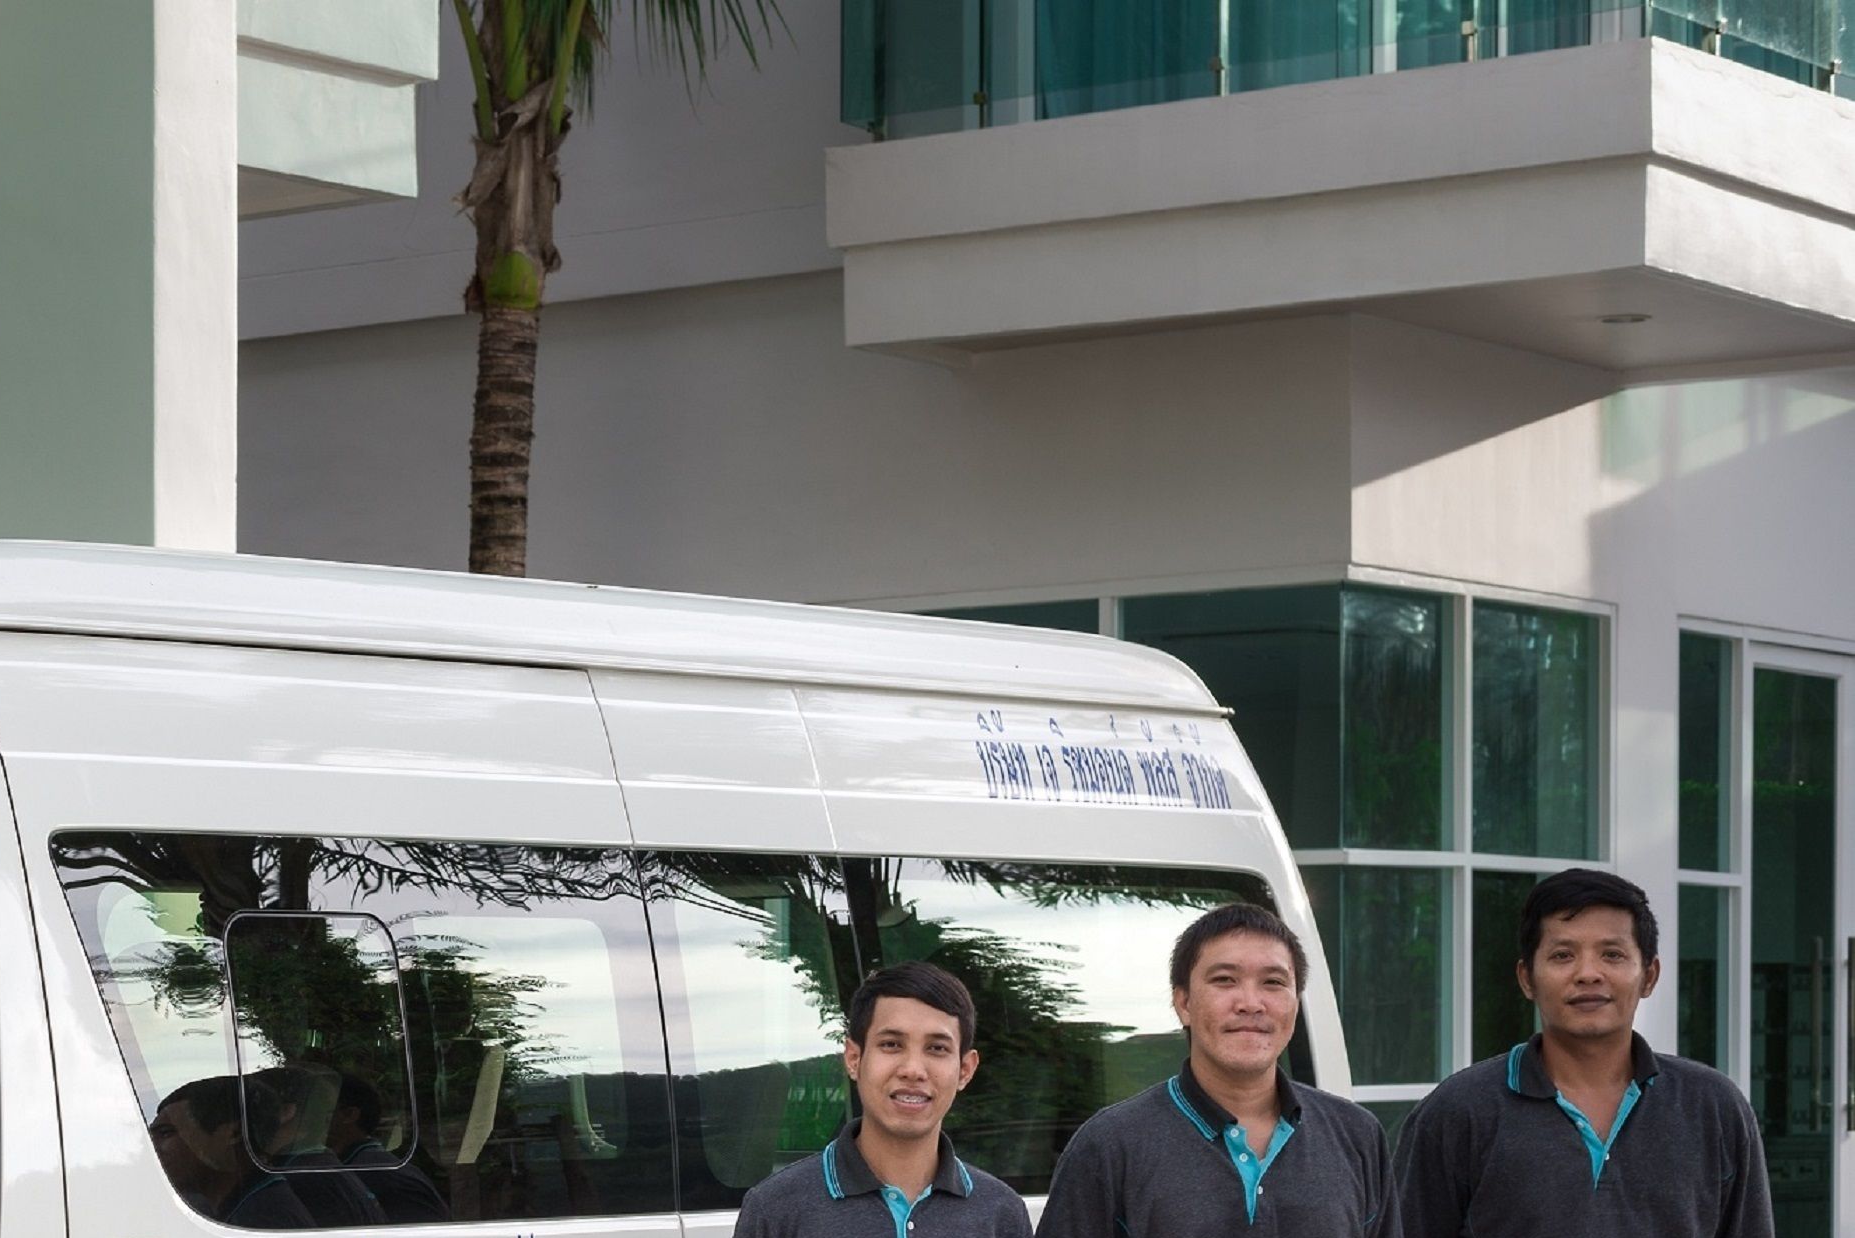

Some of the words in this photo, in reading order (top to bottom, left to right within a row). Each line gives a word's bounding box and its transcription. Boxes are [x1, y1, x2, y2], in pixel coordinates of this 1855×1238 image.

[976, 709, 1034, 799] บริษัท
[1136, 719, 1183, 807] พลัส
[1172, 723, 1232, 810] จำกัด
